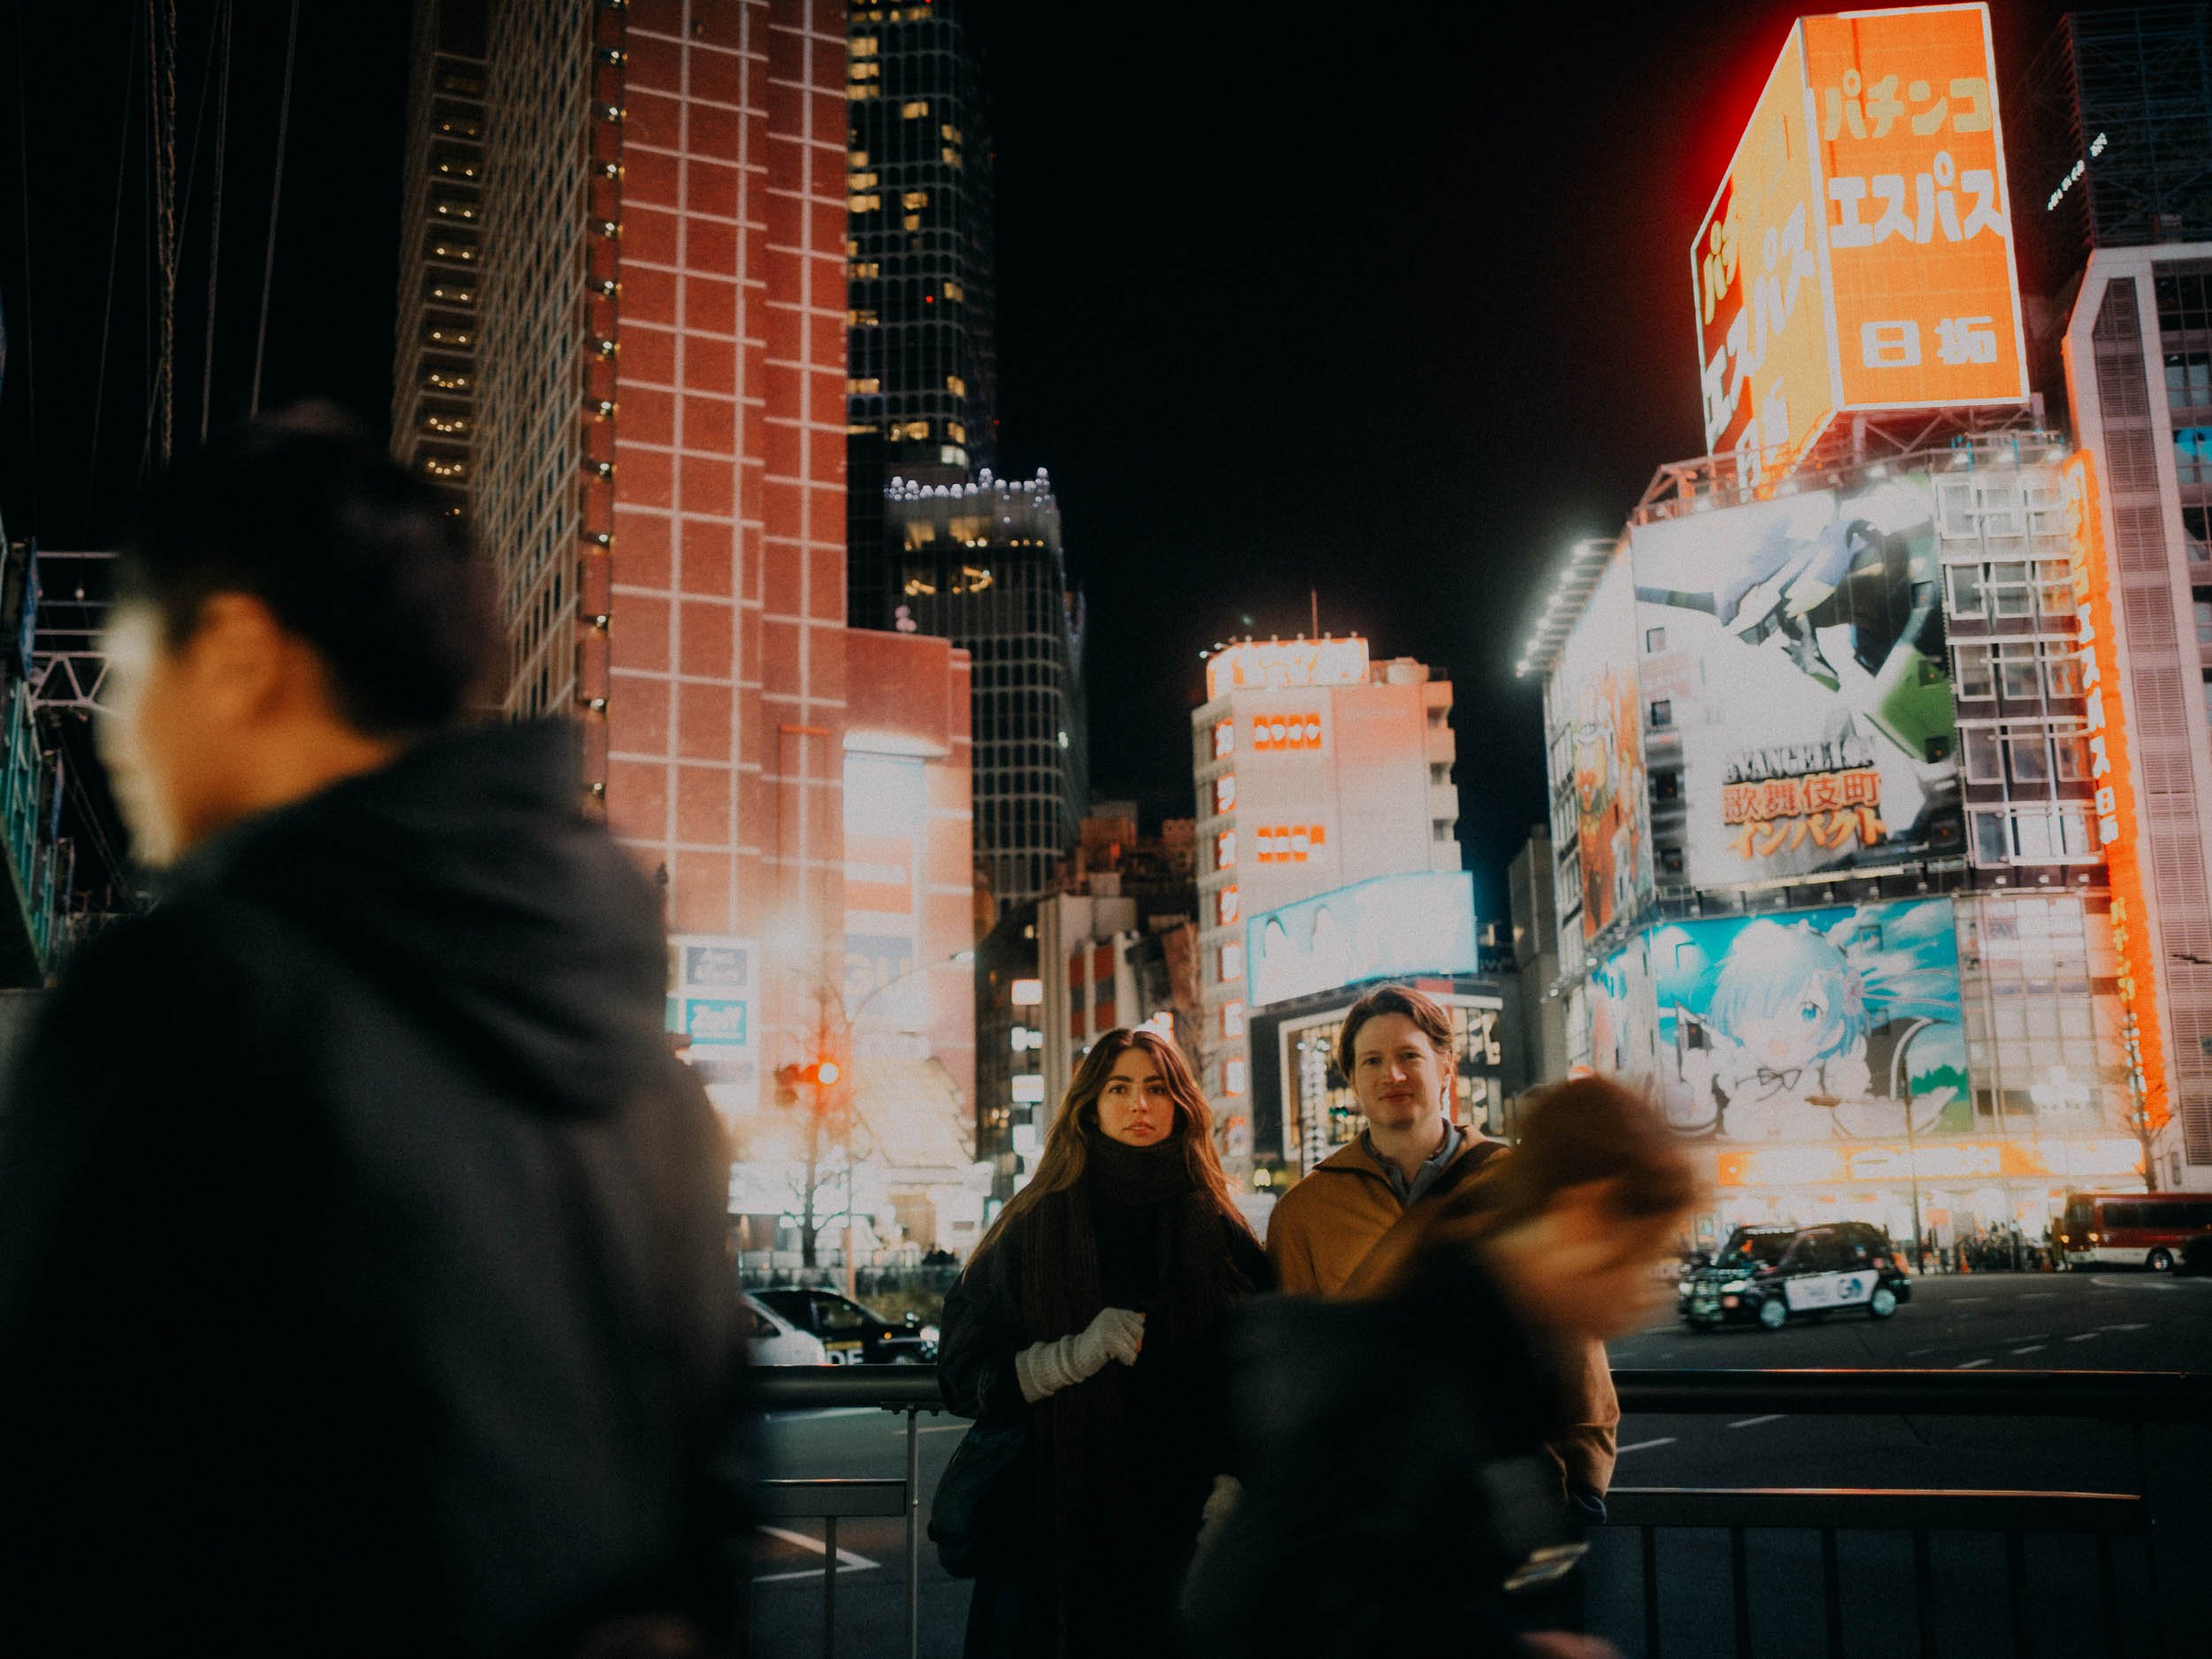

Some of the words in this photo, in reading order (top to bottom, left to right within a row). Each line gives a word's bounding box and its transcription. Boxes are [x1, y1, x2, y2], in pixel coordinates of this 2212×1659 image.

[1823, 68, 1992, 141] パチンコ
[1828, 150, 2005, 249] エスパス
[1724, 770, 1881, 824] 歌舞伎町
[1726, 806, 1886, 860] インパクト
